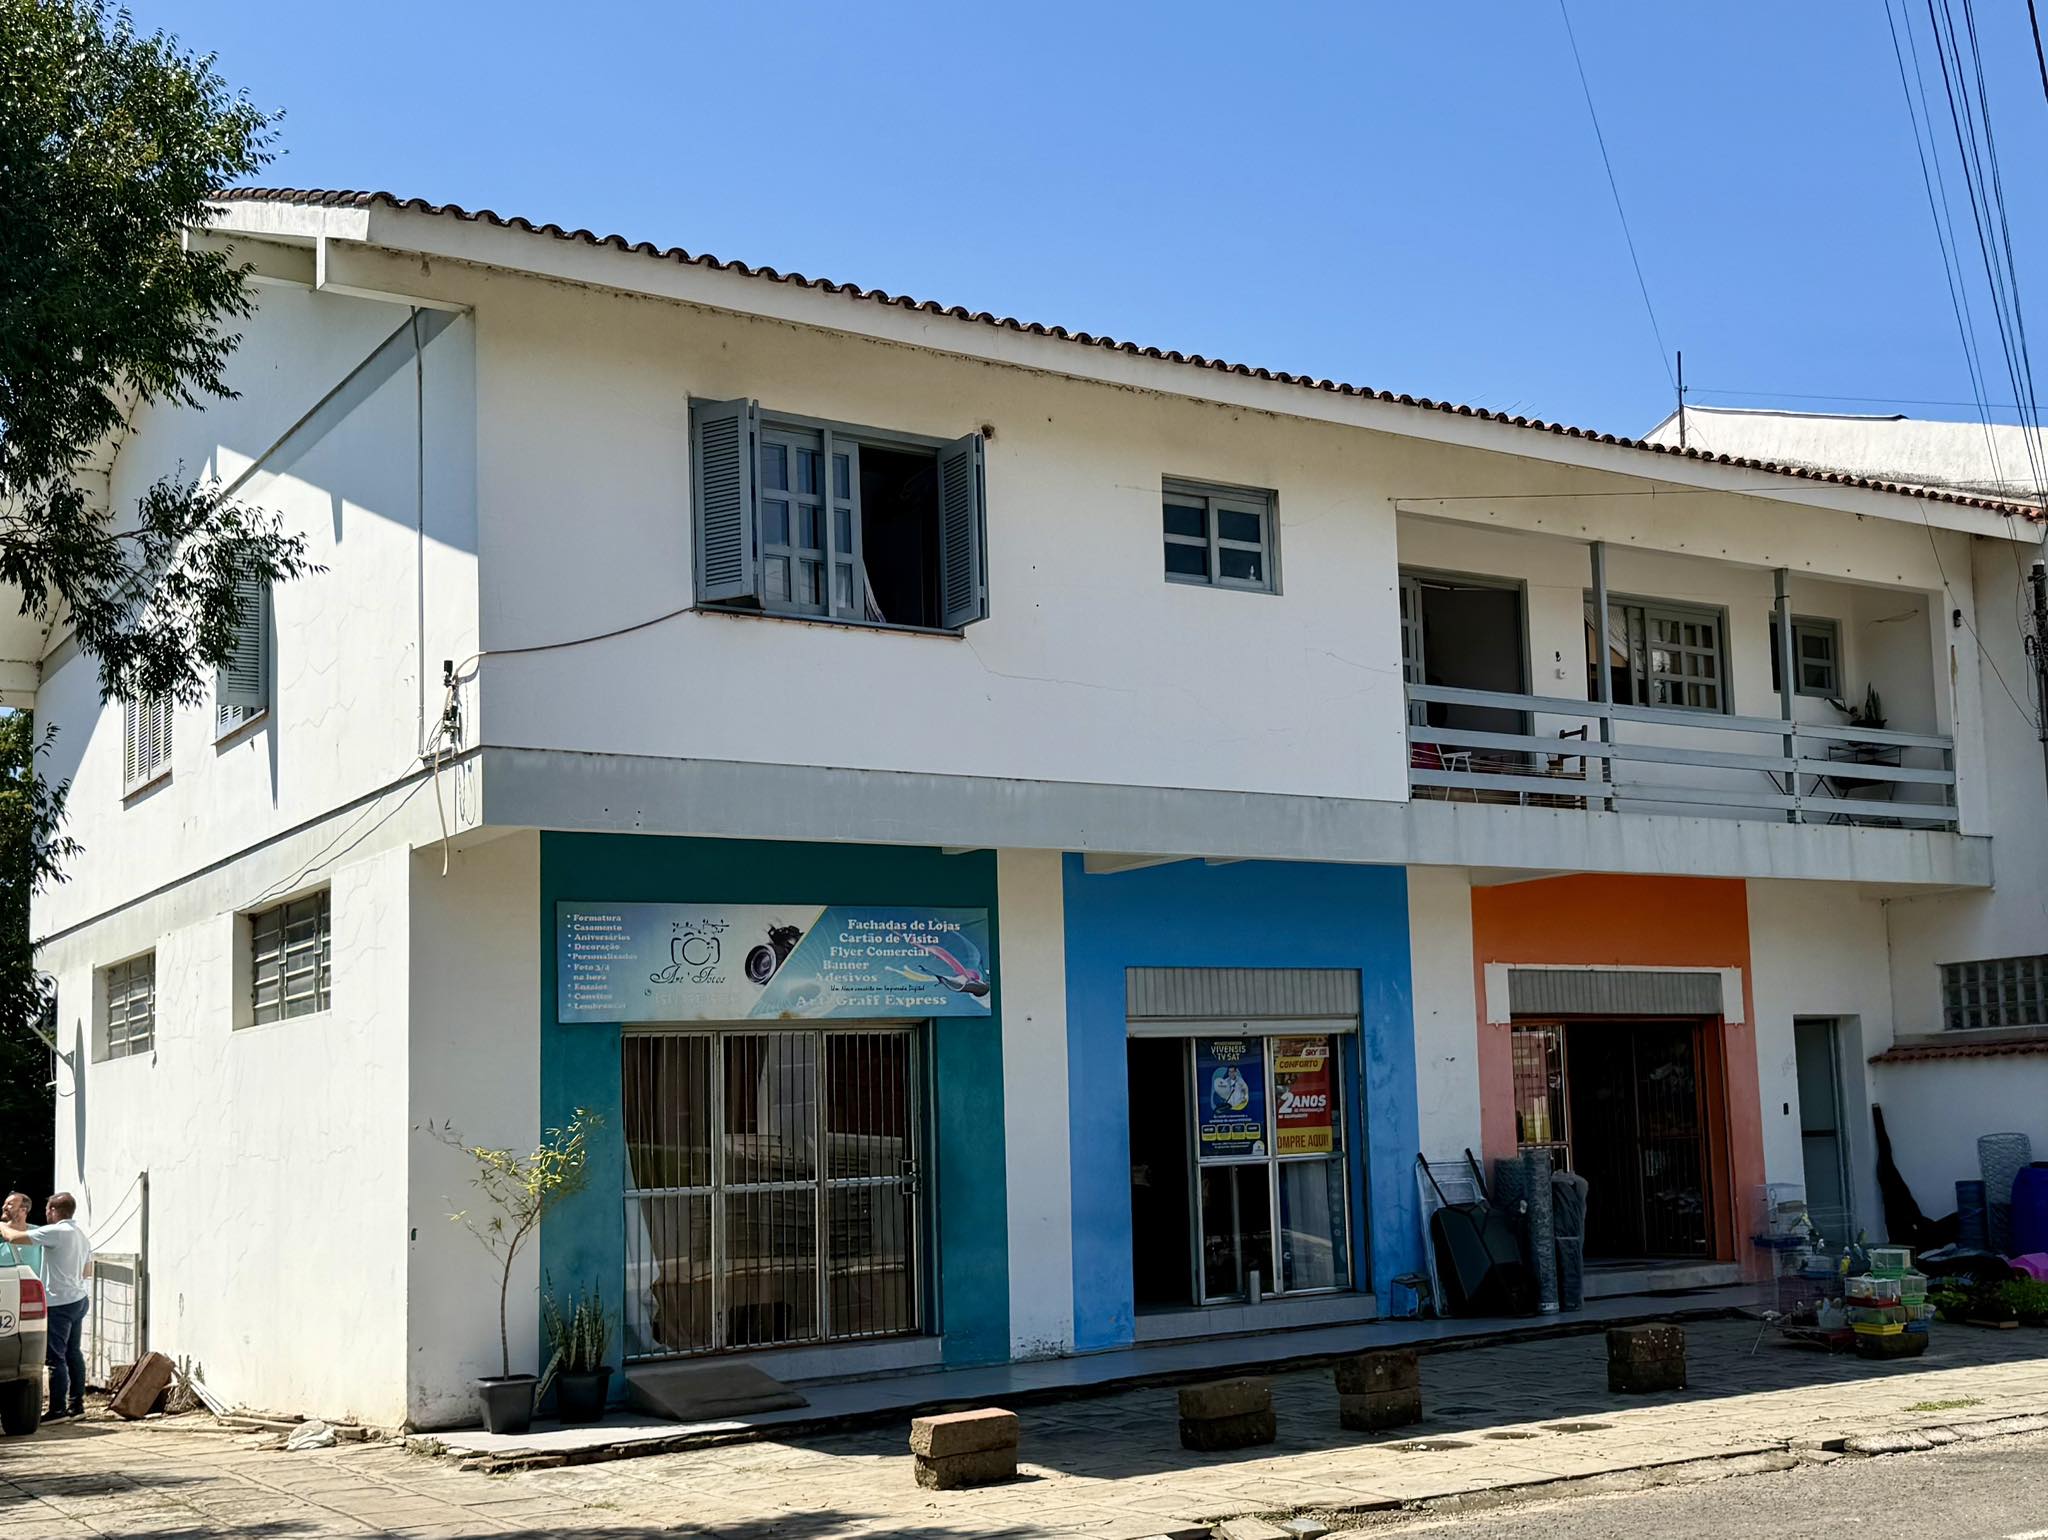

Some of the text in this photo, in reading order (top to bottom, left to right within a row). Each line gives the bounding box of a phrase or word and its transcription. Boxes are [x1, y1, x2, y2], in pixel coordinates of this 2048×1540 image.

[573, 914, 622, 922] Formatura
[847, 919, 960, 932] Fachadas de Lojas
[839, 933, 939, 944] Cartão de Visita
[574, 943, 621, 952] Decoração
[830, 946, 930, 958] Flyer Comercial
[822, 960, 869, 970] Banner
[691, 966, 727, 984] Fotos
[815, 972, 878, 982] Adesivos
[836, 995, 880, 1006] Graff
[885, 995, 948, 1008] Express
[1211, 1045, 1246, 1055] VIVENSIS
[1227, 1053, 1240, 1061] SAT
[1279, 1060, 1319, 1069] CONFORTO
[1278, 1092, 1327, 1114] 2 ANOS
[1277, 1135, 1306, 1149] OMPRE
